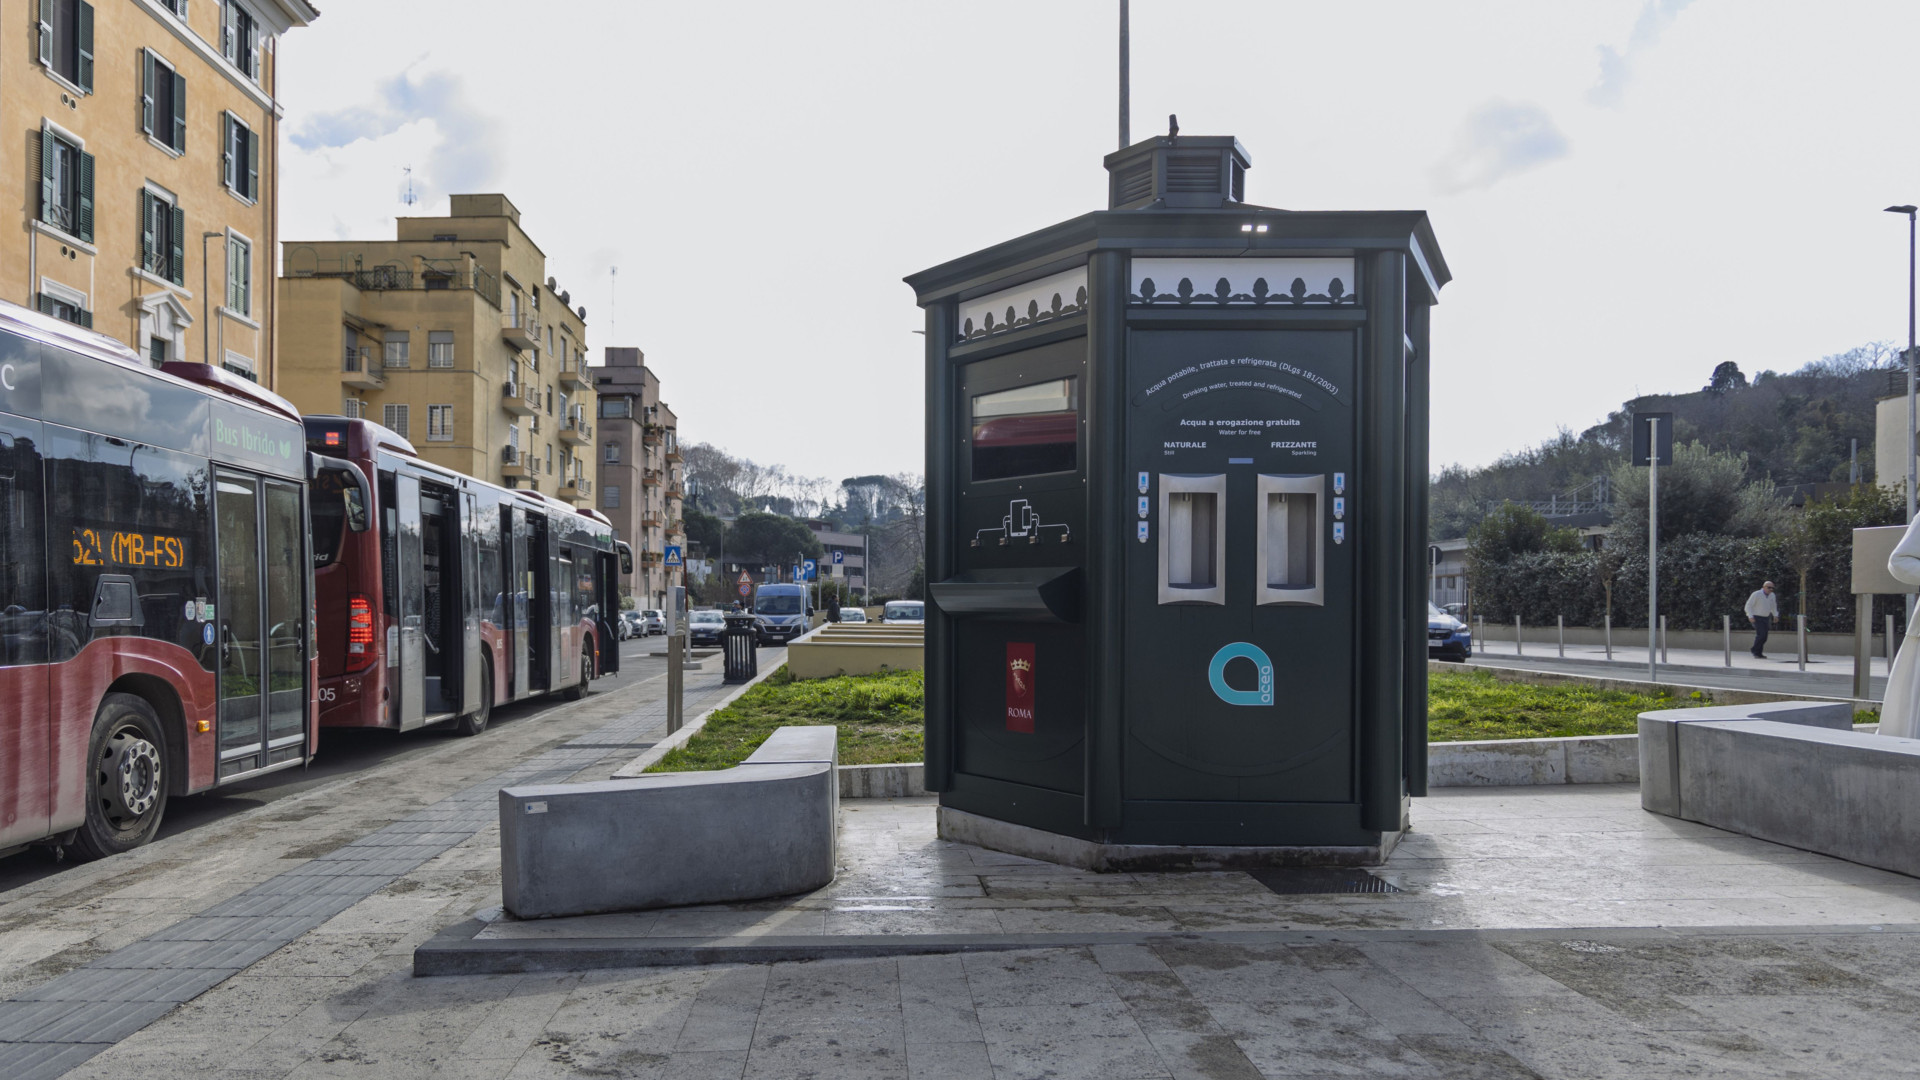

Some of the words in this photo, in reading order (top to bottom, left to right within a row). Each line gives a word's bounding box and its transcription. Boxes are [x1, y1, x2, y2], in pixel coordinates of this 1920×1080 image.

[1145, 379, 1167, 396] Acqua
[1167, 366, 1199, 384] potabile,
[1200, 359, 1229, 370] trattata
[1237, 357, 1277, 368] refrigerata
[1279, 362, 1301, 375] (DLgs
[1302, 370, 1339, 395] 181/2003)
[1182, 386, 1208, 399] Drinking
[1209, 381, 1228, 390] water,
[1253, 380, 1266, 388] and
[1266, 383, 1302, 399] refrigerated
[1180, 419, 1207, 428] Acqua
[1216, 418, 1264, 428] erogazione
[1266, 418, 1301, 428] gratuita
[215, 418, 238, 447] Bus
[241, 424, 276, 456] Ibrido
[1164, 441, 1207, 449] NATURALE
[1270, 441, 1317, 449] FRIZZANTE
[111, 531, 184, 567] (MB-FS)
[1261, 665, 1271, 703] acea
[1008, 706, 1032, 719] ROMA
